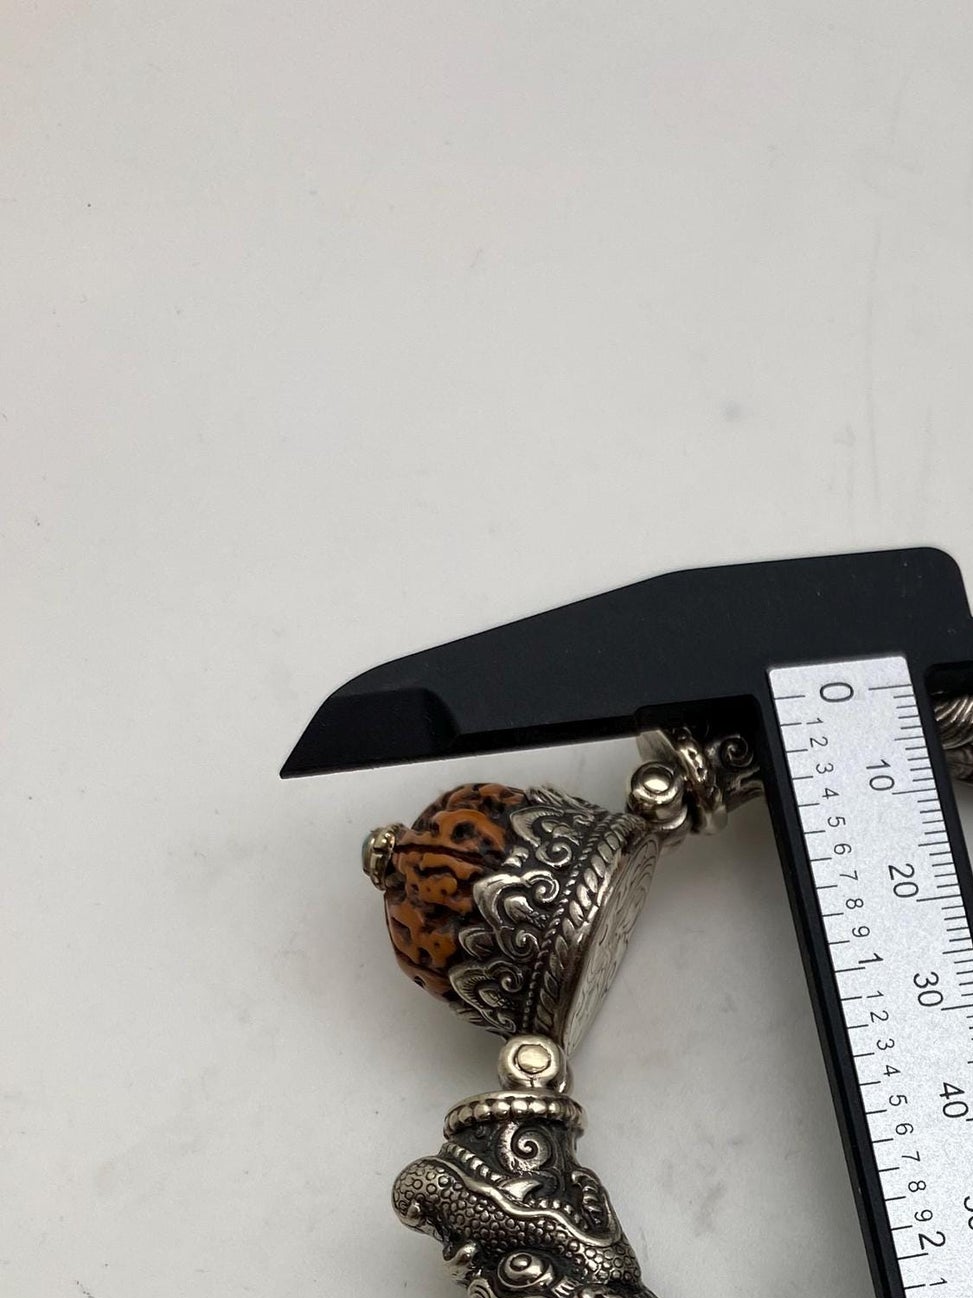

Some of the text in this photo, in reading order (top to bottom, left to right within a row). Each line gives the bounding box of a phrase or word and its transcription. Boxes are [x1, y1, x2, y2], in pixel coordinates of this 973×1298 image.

[810, 736, 828, 748] 2
[816, 763, 834, 774] 3
[822, 788, 839, 799] 4
[828, 817, 846, 827] 5
[834, 843, 852, 855] 6
[840, 870, 858, 880] 7
[820, 682, 854, 702] 0
[866, 759, 895, 791] 10
[888, 863, 919, 898] 20
[913, 972, 943, 1007] 30
[940, 1082, 968, 1118] 40
[846, 898, 864, 909] 8
[852, 926, 870, 937] 9
[858, 953, 883, 964] 1
[870, 1010, 889, 1023] 2
[876, 1039, 895, 1050] 3
[884, 1065, 900, 1077] 4
[889, 1095, 908, 1106] 5
[895, 1123, 914, 1135] 6
[902, 1151, 920, 1161] 7
[908, 1180, 926, 1192] 8
[914, 1210, 933, 1221] 9
[918, 1231, 945, 1250] 2
[930, 1278, 947, 1286] 1
